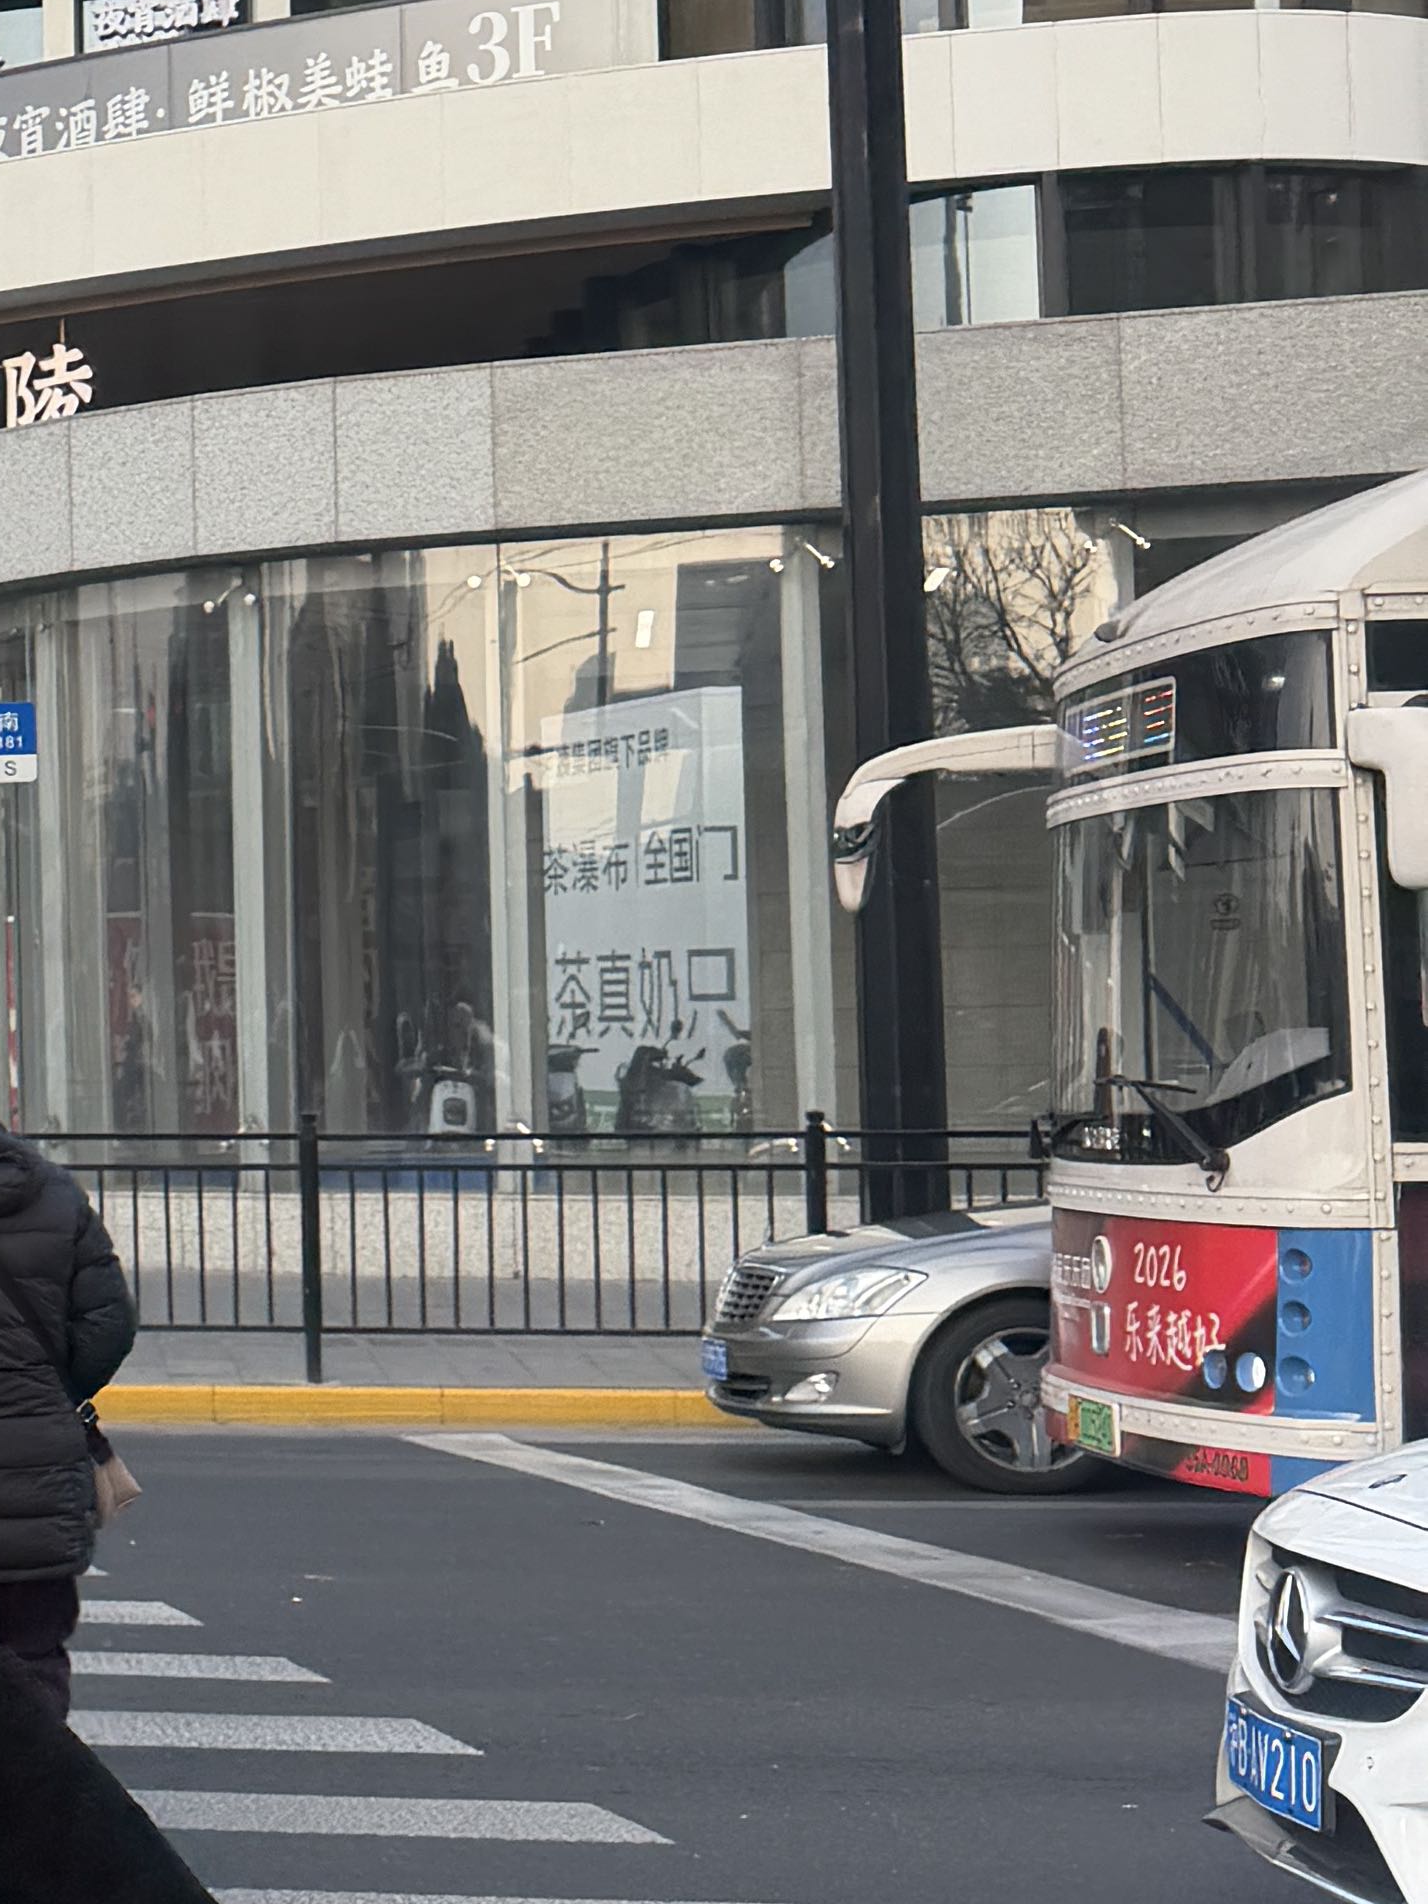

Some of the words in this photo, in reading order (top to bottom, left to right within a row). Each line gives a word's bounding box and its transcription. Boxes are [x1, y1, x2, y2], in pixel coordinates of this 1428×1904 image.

[4, 761, 17, 776] S
[1134, 1242, 1187, 1291] 2026
[1125, 1301, 1226, 1370] 乐来越好
